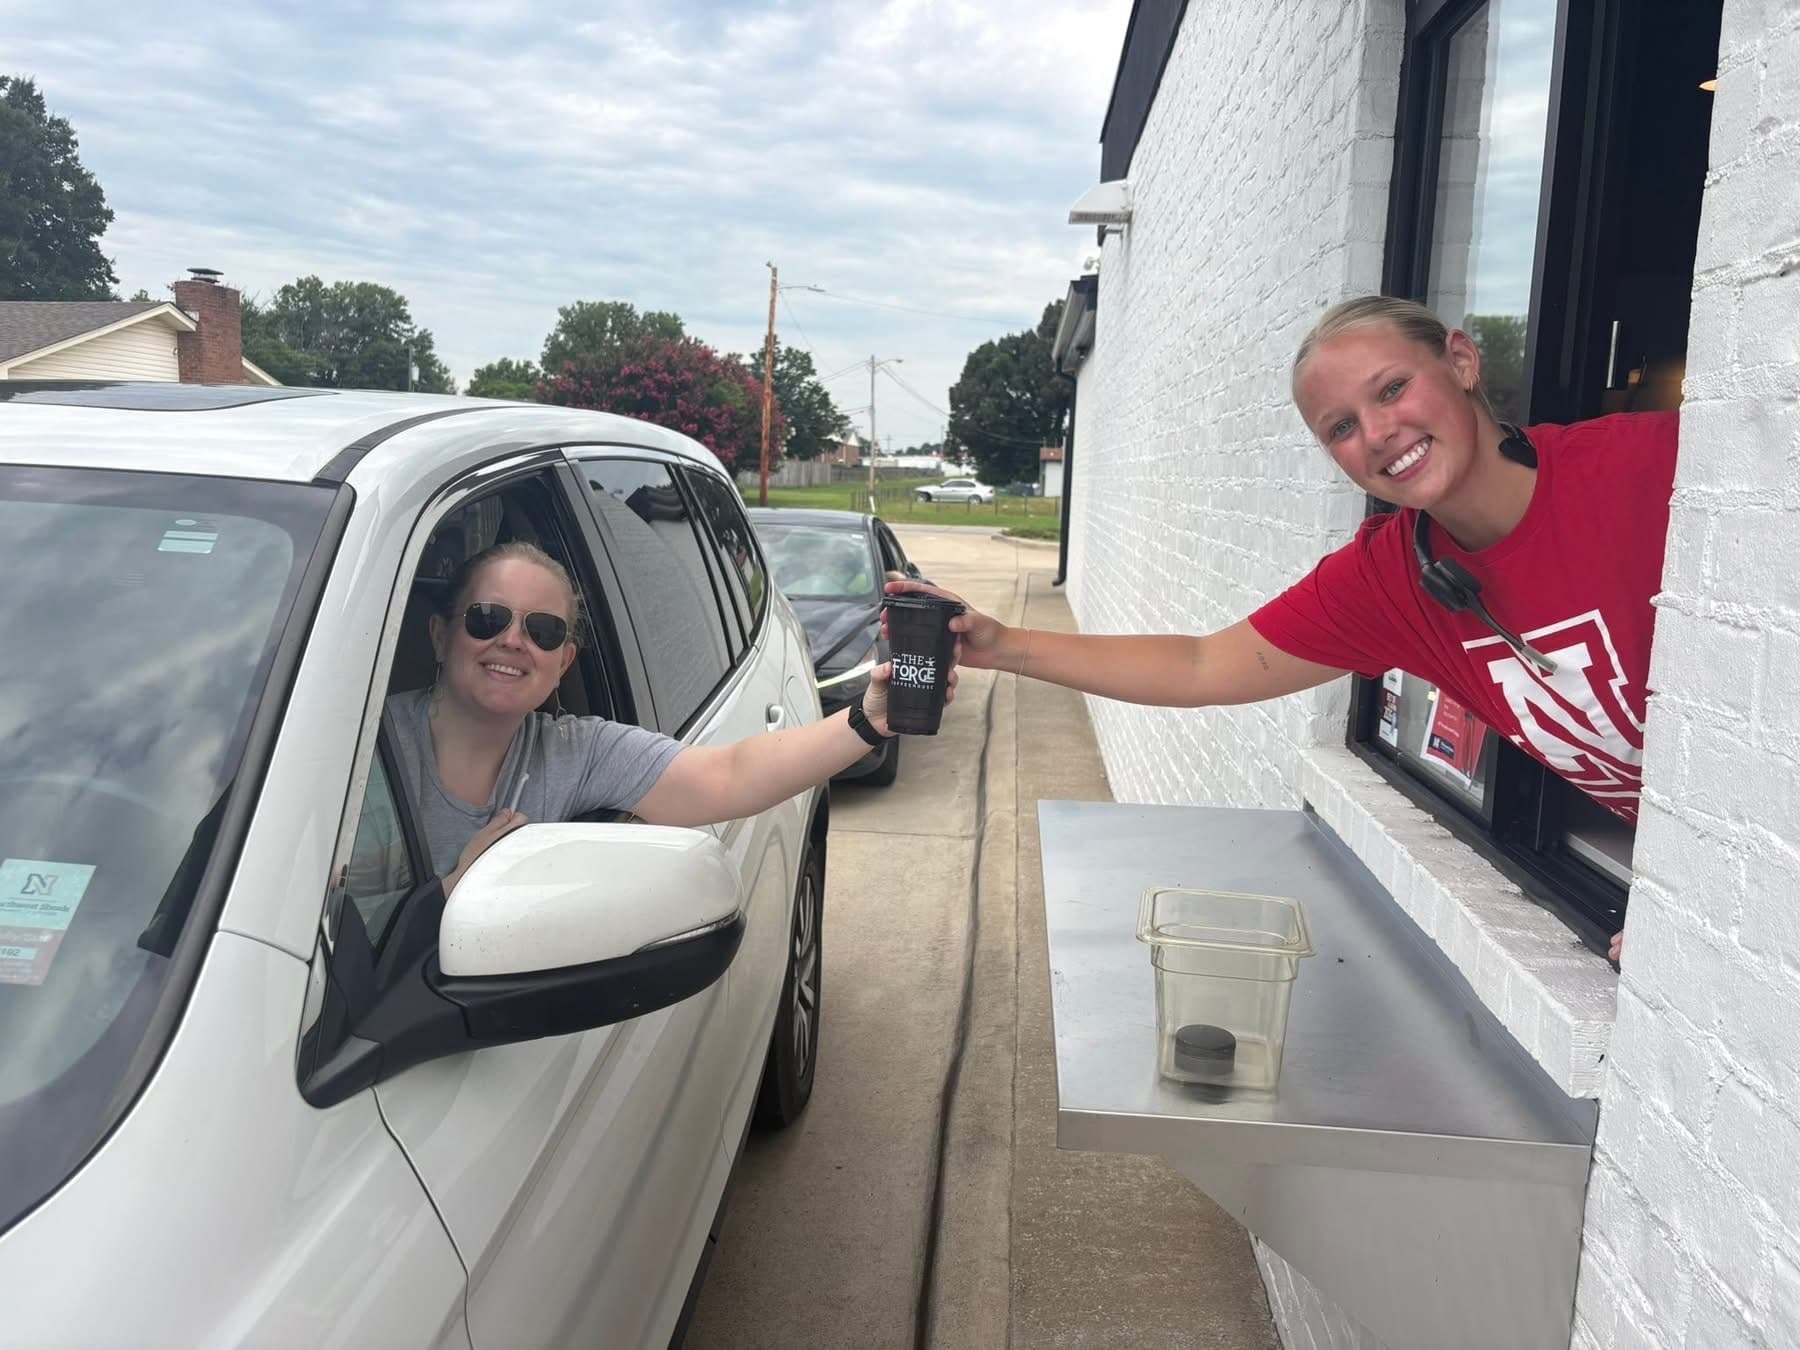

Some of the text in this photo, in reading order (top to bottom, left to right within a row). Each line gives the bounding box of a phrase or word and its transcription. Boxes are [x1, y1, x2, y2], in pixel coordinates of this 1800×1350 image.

[892, 658, 936, 684] FORGE
[901, 653, 925, 666] THE
[1480, 634, 1645, 777] N
